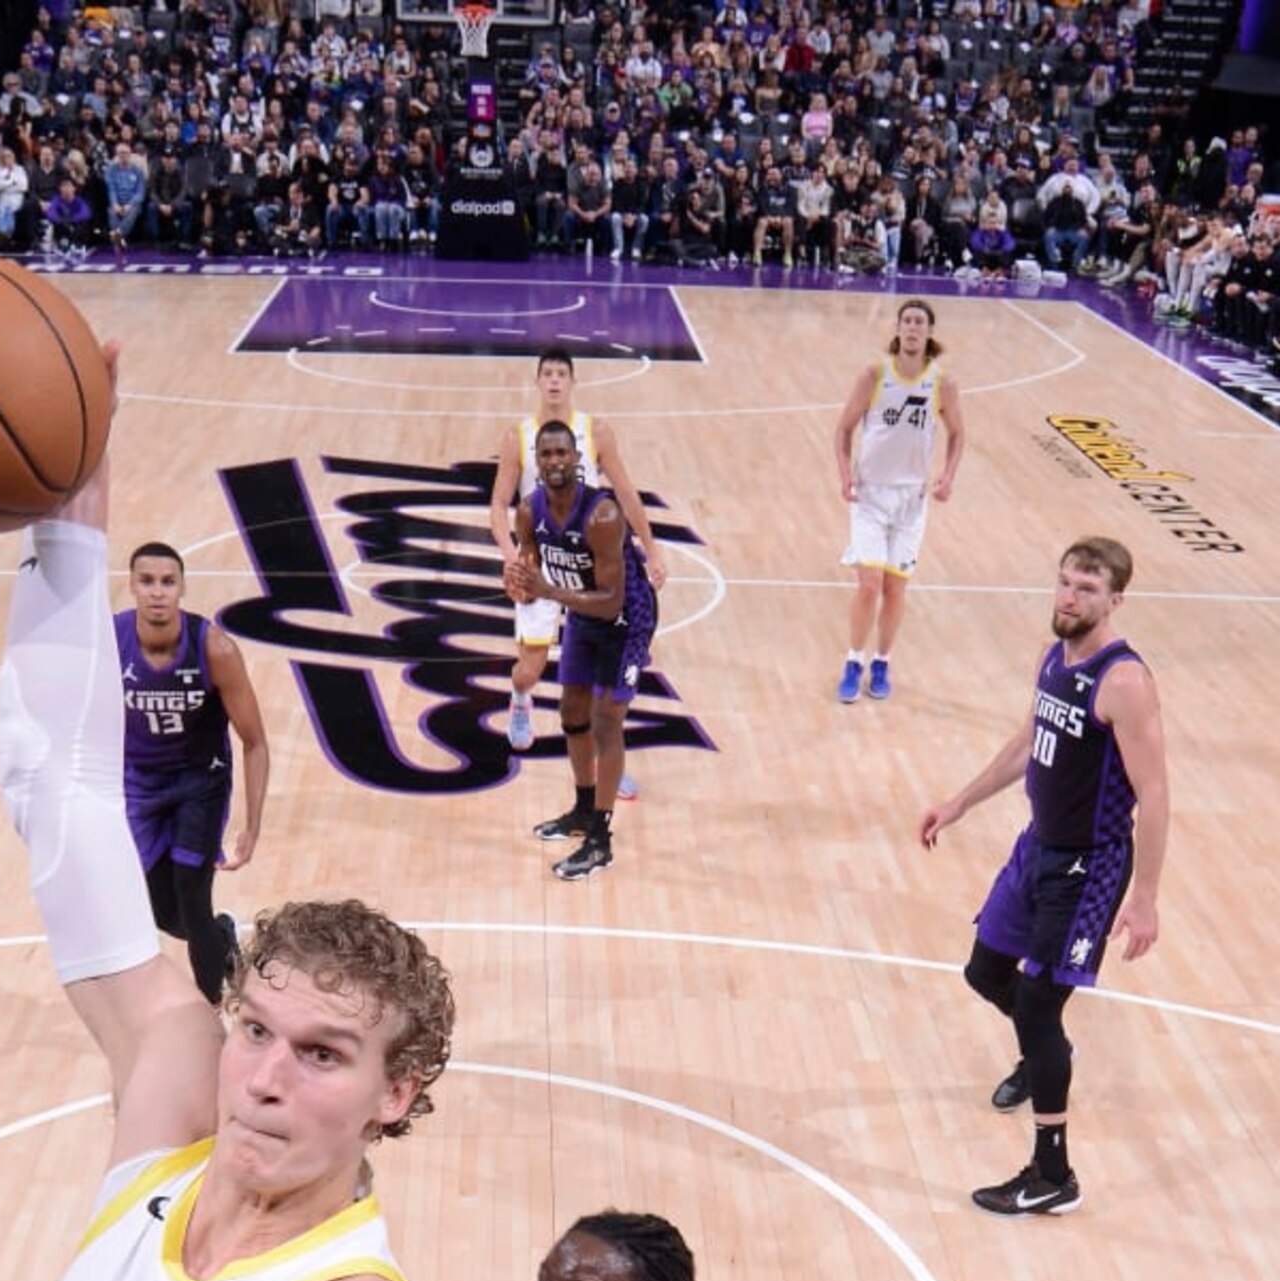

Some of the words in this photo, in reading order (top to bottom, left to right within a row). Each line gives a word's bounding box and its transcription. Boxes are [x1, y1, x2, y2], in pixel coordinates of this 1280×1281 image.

[451, 198, 501, 217] dialpad
[907, 407, 928, 431] 41
[1119, 481, 1245, 553] CENTER
[145, 711, 185, 735] 13
[1033, 726, 1058, 768] 10
